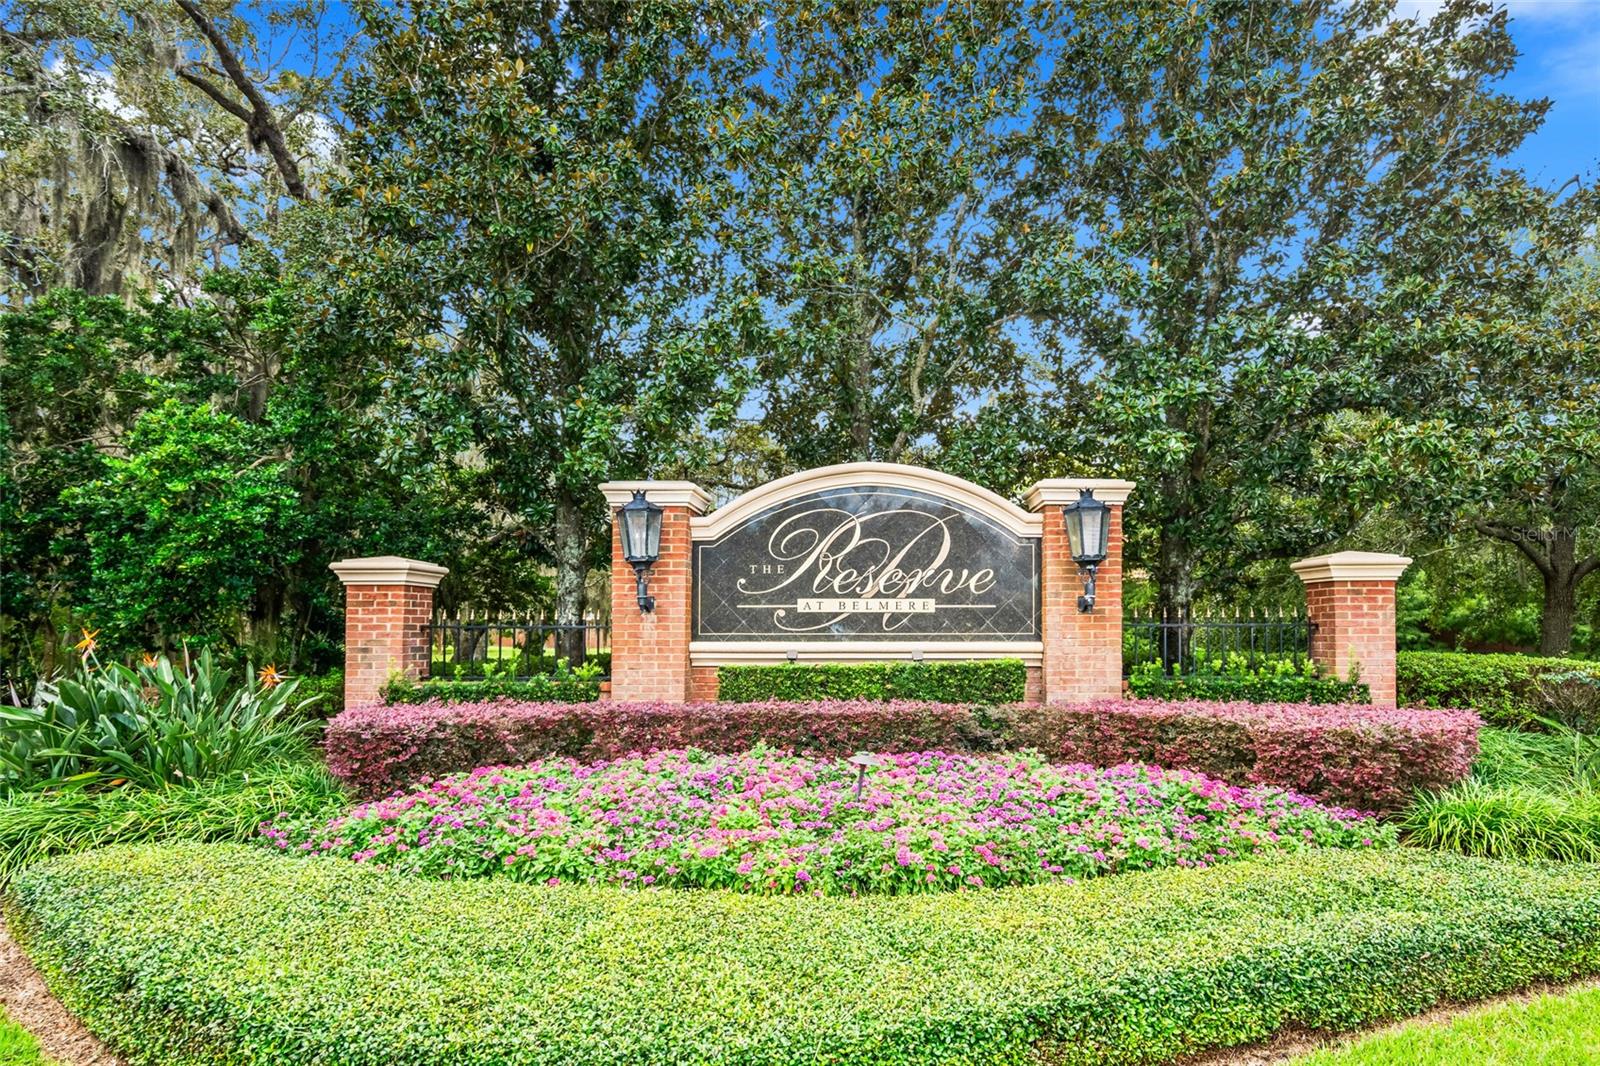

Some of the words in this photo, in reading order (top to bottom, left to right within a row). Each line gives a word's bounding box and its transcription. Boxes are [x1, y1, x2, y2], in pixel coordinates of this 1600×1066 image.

[737, 508, 997, 595] Reserve
[749, 564, 785, 575] THE
[803, 601, 825, 611] AT
[838, 601, 931, 611] BELMERE
